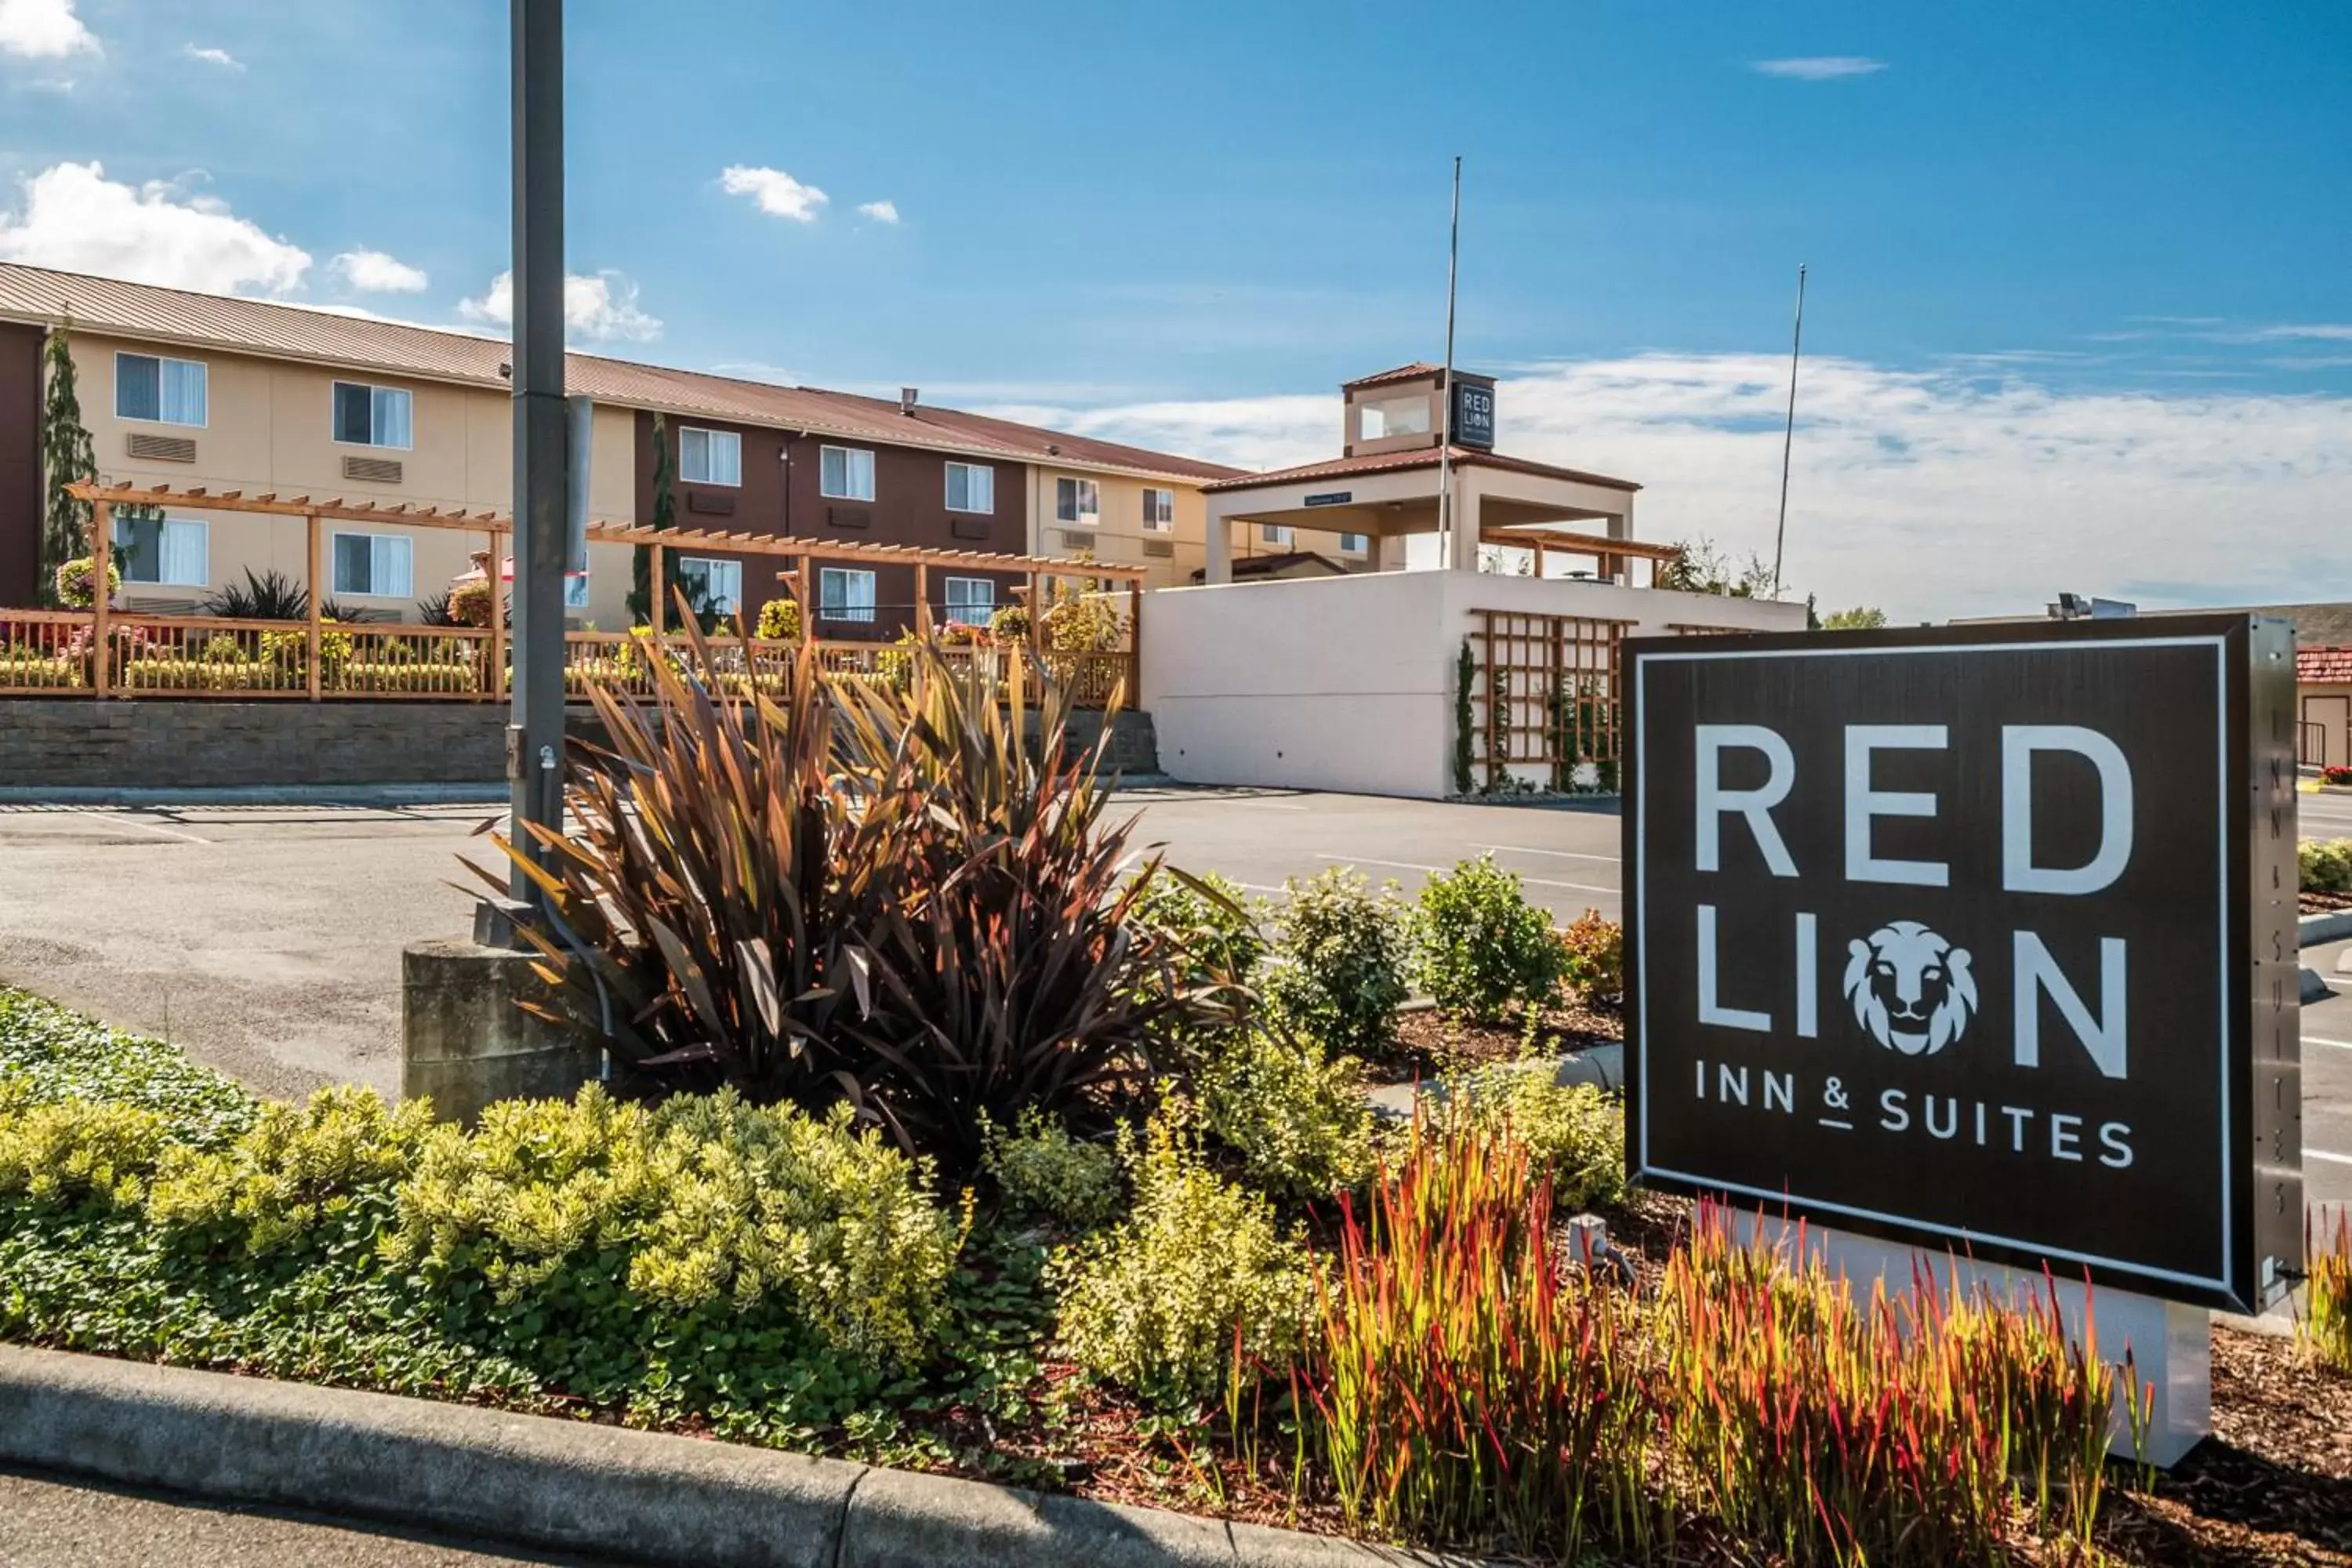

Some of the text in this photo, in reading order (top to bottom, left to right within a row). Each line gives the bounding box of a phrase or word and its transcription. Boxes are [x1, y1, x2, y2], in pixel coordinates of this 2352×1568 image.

[1464, 393, 1490, 413] RED
[1695, 724, 2134, 895] RED
[1696, 1059, 2135, 1168] INN & SUITES
